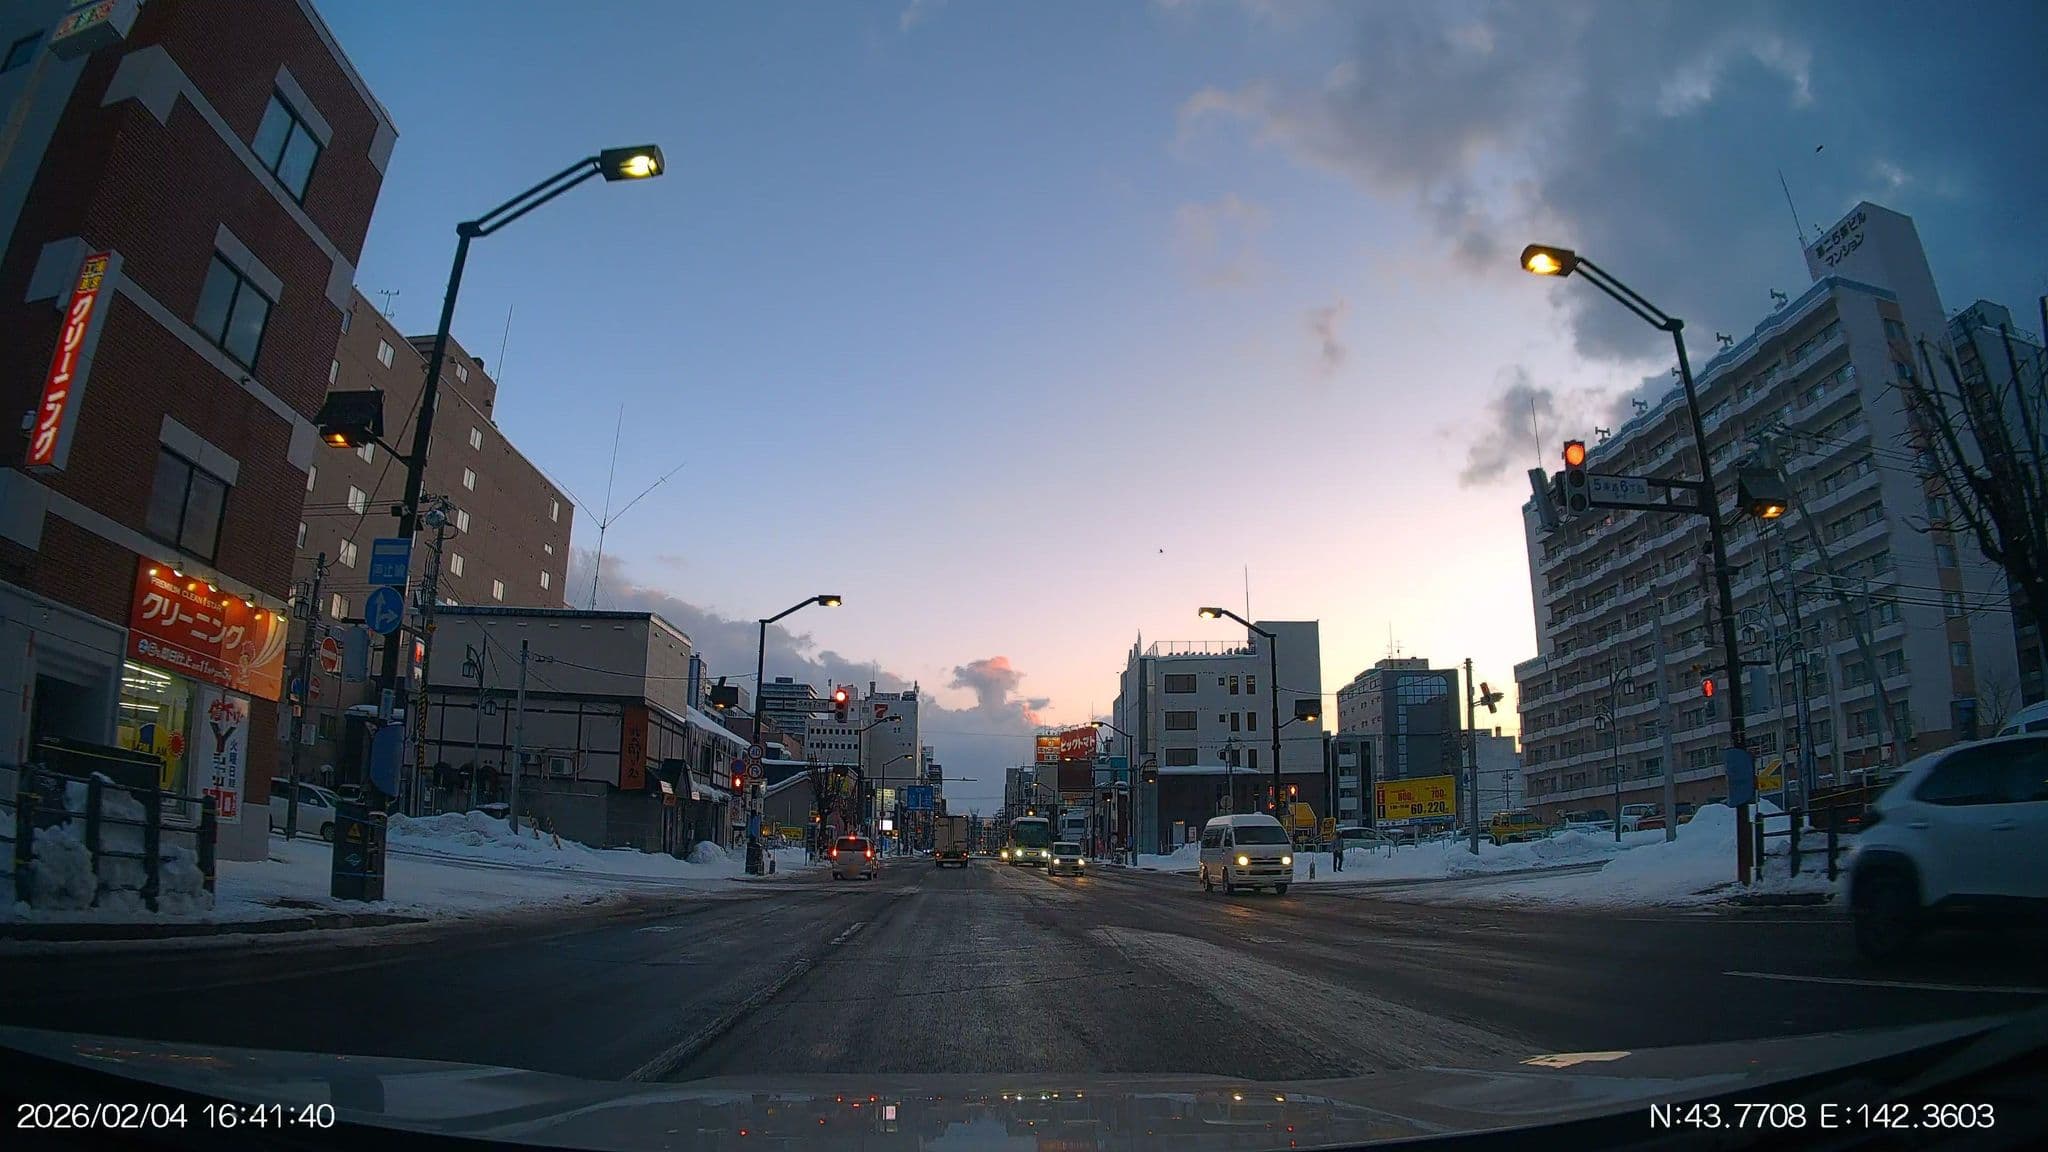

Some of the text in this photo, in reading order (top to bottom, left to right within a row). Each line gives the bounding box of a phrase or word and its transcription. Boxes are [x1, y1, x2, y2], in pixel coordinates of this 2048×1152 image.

[1825, 231, 1865, 267] マンション
[34, 294, 94, 461] クリーニング
[142, 592, 246, 650] クリーニング
[181, 589, 203, 606] CLEAN
